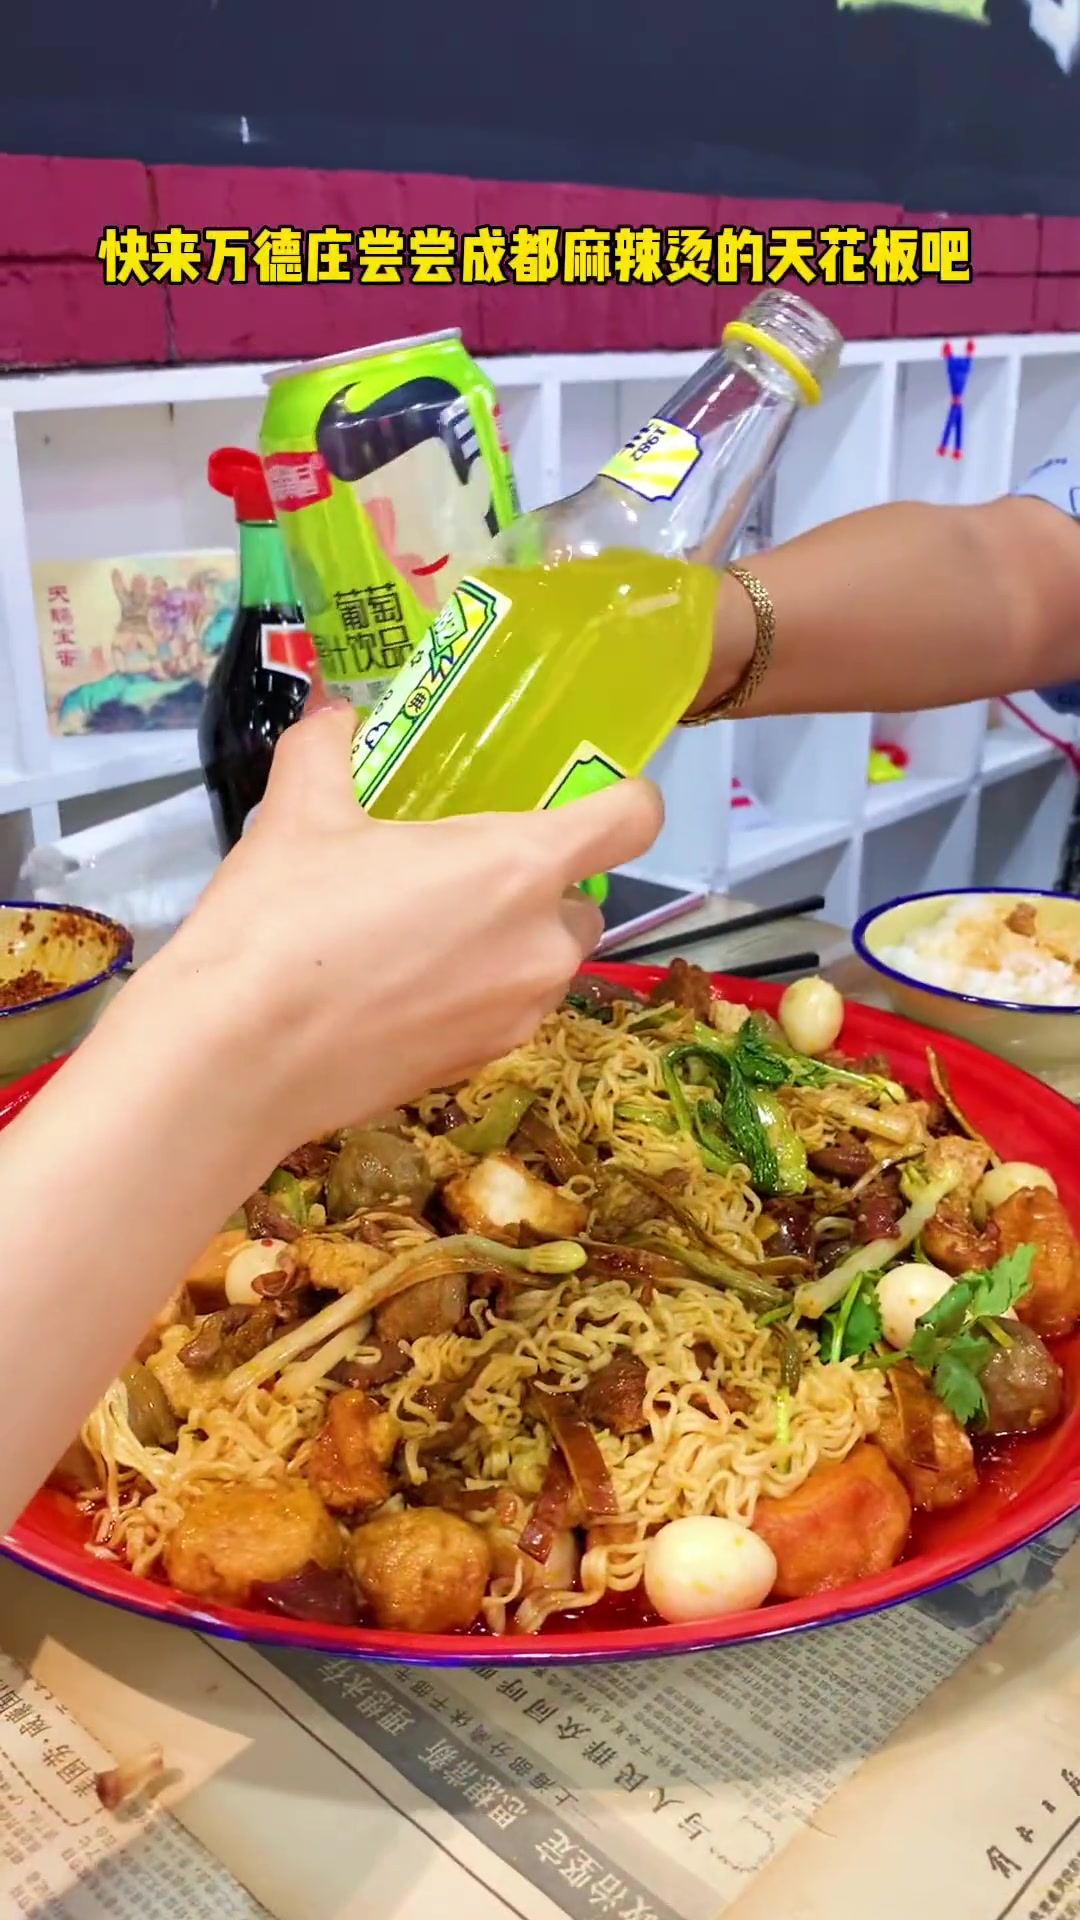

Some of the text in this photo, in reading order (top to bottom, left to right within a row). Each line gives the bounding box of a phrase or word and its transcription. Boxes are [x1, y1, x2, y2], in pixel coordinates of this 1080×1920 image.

[334, 583, 403, 631] 葡萄
[317, 1660, 415, 1736] 理想永存
[418, 1738, 529, 1829] 思想常新
